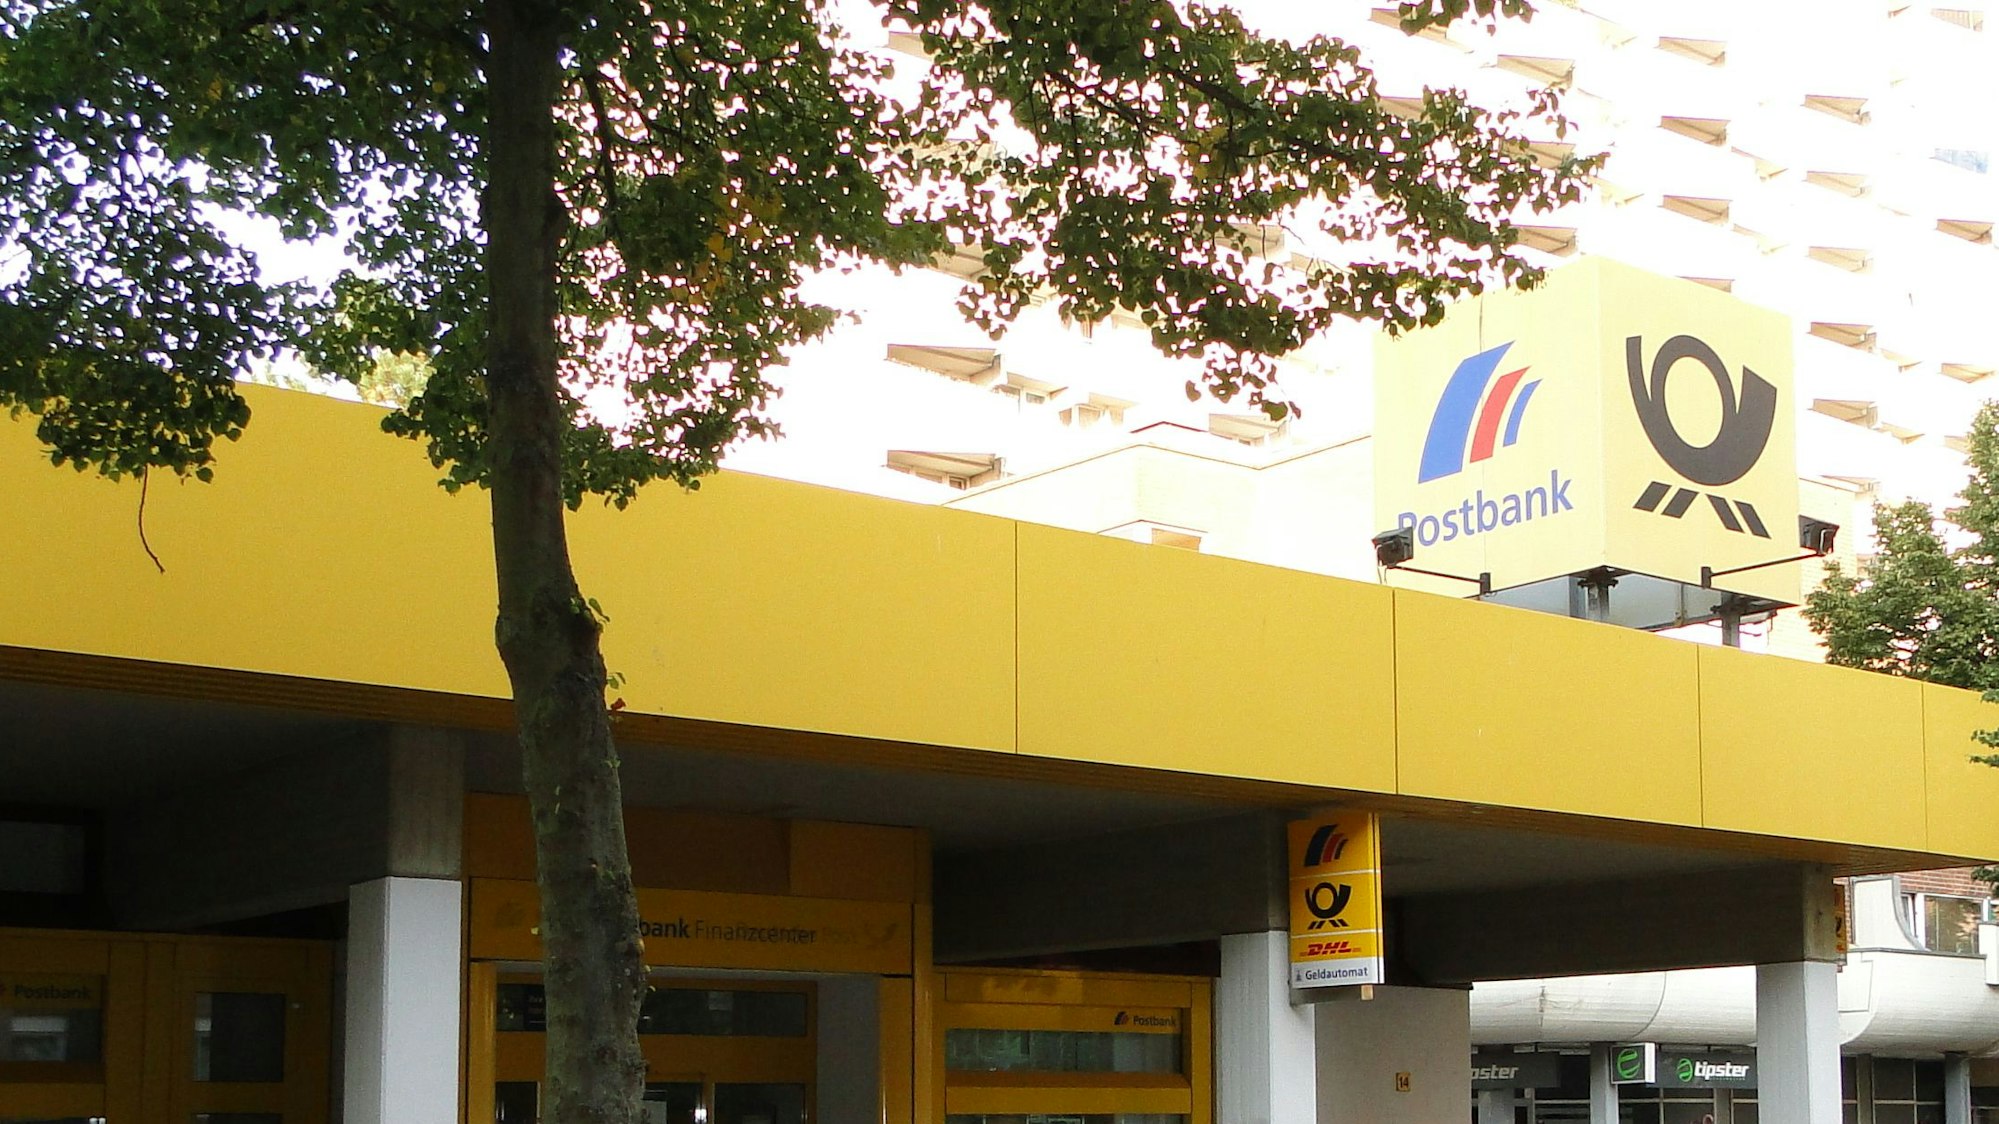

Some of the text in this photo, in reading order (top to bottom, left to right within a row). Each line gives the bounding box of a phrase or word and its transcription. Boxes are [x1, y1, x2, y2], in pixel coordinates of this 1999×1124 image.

[639, 917, 690, 938] bank
[695, 919, 817, 944] Finanzcenter
[1307, 941, 1351, 956] DHL
[1305, 967, 1368, 980] Geldautomat
[14, 984, 90, 999] Postbank
[1133, 1015, 1176, 1026] Postbank
[1471, 1064, 1519, 1080] pster
[1694, 1061, 1750, 1080] tipster
[1399, 1077, 1409, 1088] 14
